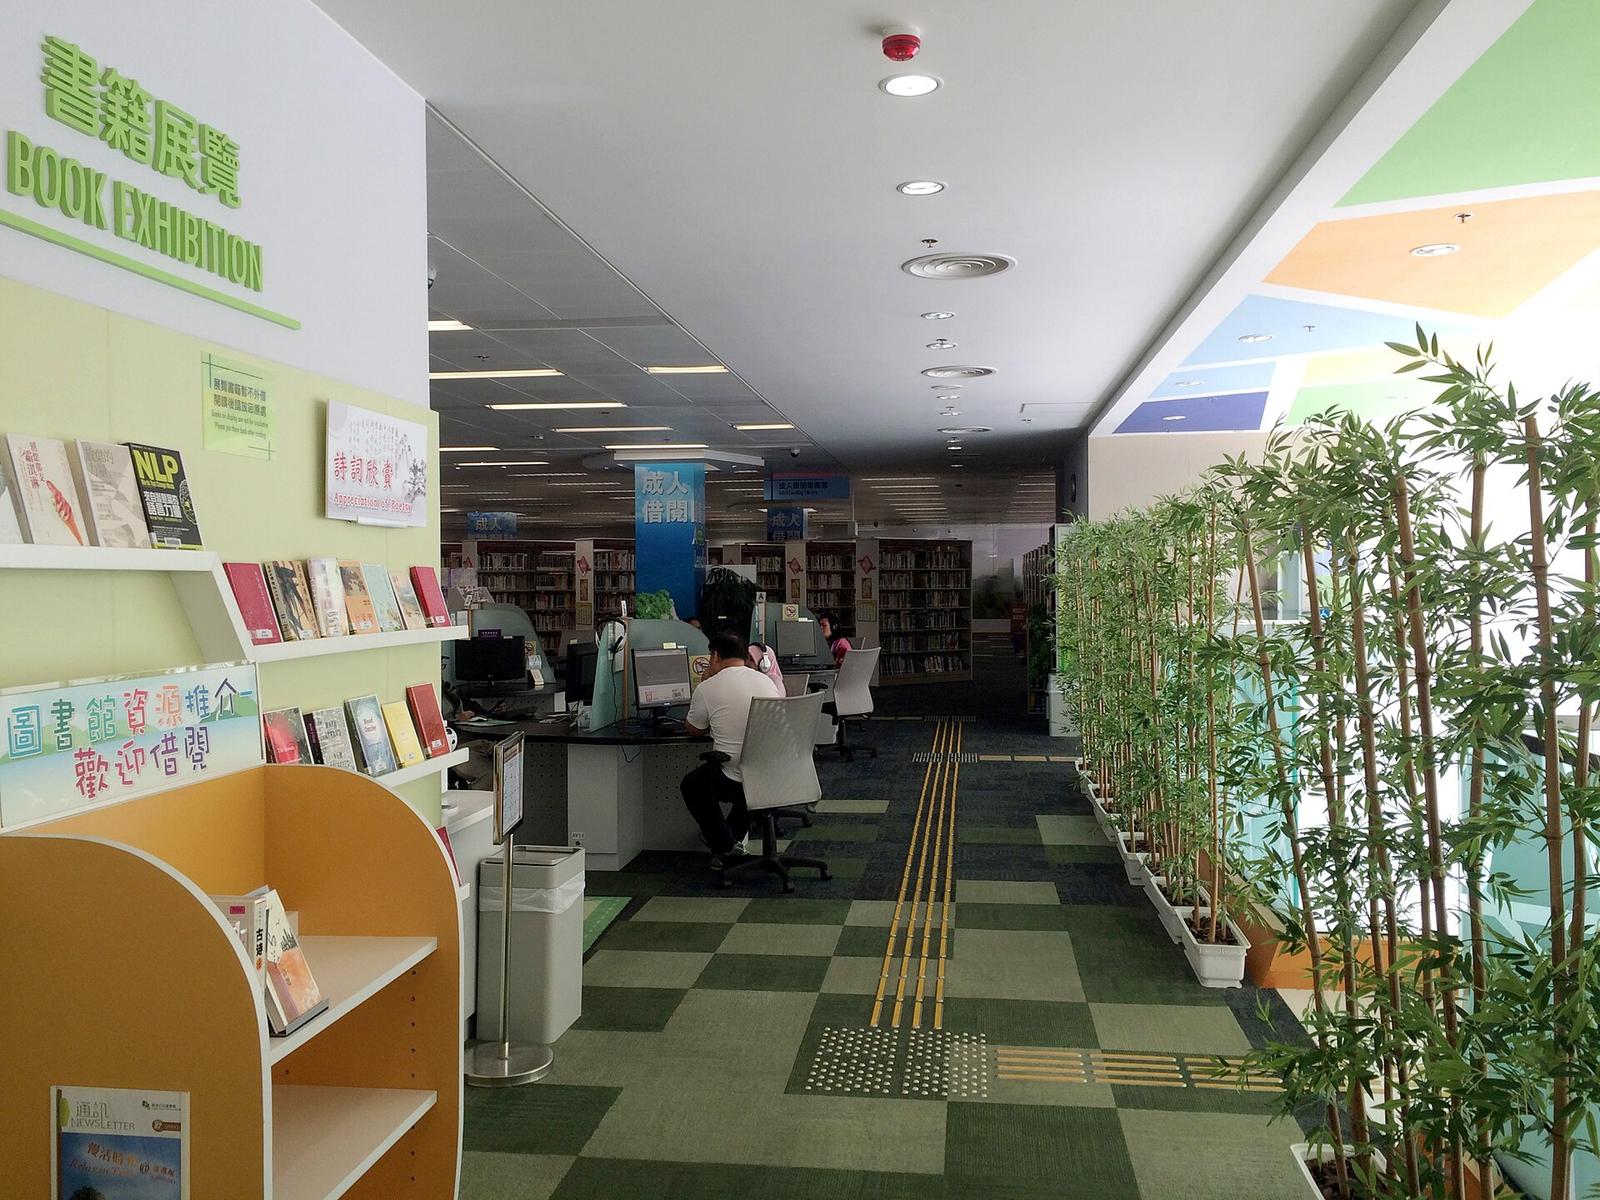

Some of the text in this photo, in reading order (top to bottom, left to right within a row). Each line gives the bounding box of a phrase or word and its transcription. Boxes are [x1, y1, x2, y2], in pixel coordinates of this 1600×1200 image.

[41, 35, 241, 209] 書籍展覽
[7, 130, 263, 293] BOOK EXHIBITION
[133, 450, 179, 484] NLP
[333, 450, 393, 490] 詩詞欣賞
[641, 470, 689, 496] 成人
[335, 493, 379, 509] Appreciation
[643, 500, 689, 524] 借閱
[474, 516, 503, 532] 成人
[770, 512, 801, 528] 成人
[74, 726, 210, 799] 歡迎借閱
[71, 1117, 136, 1131] NEWSLETTER
